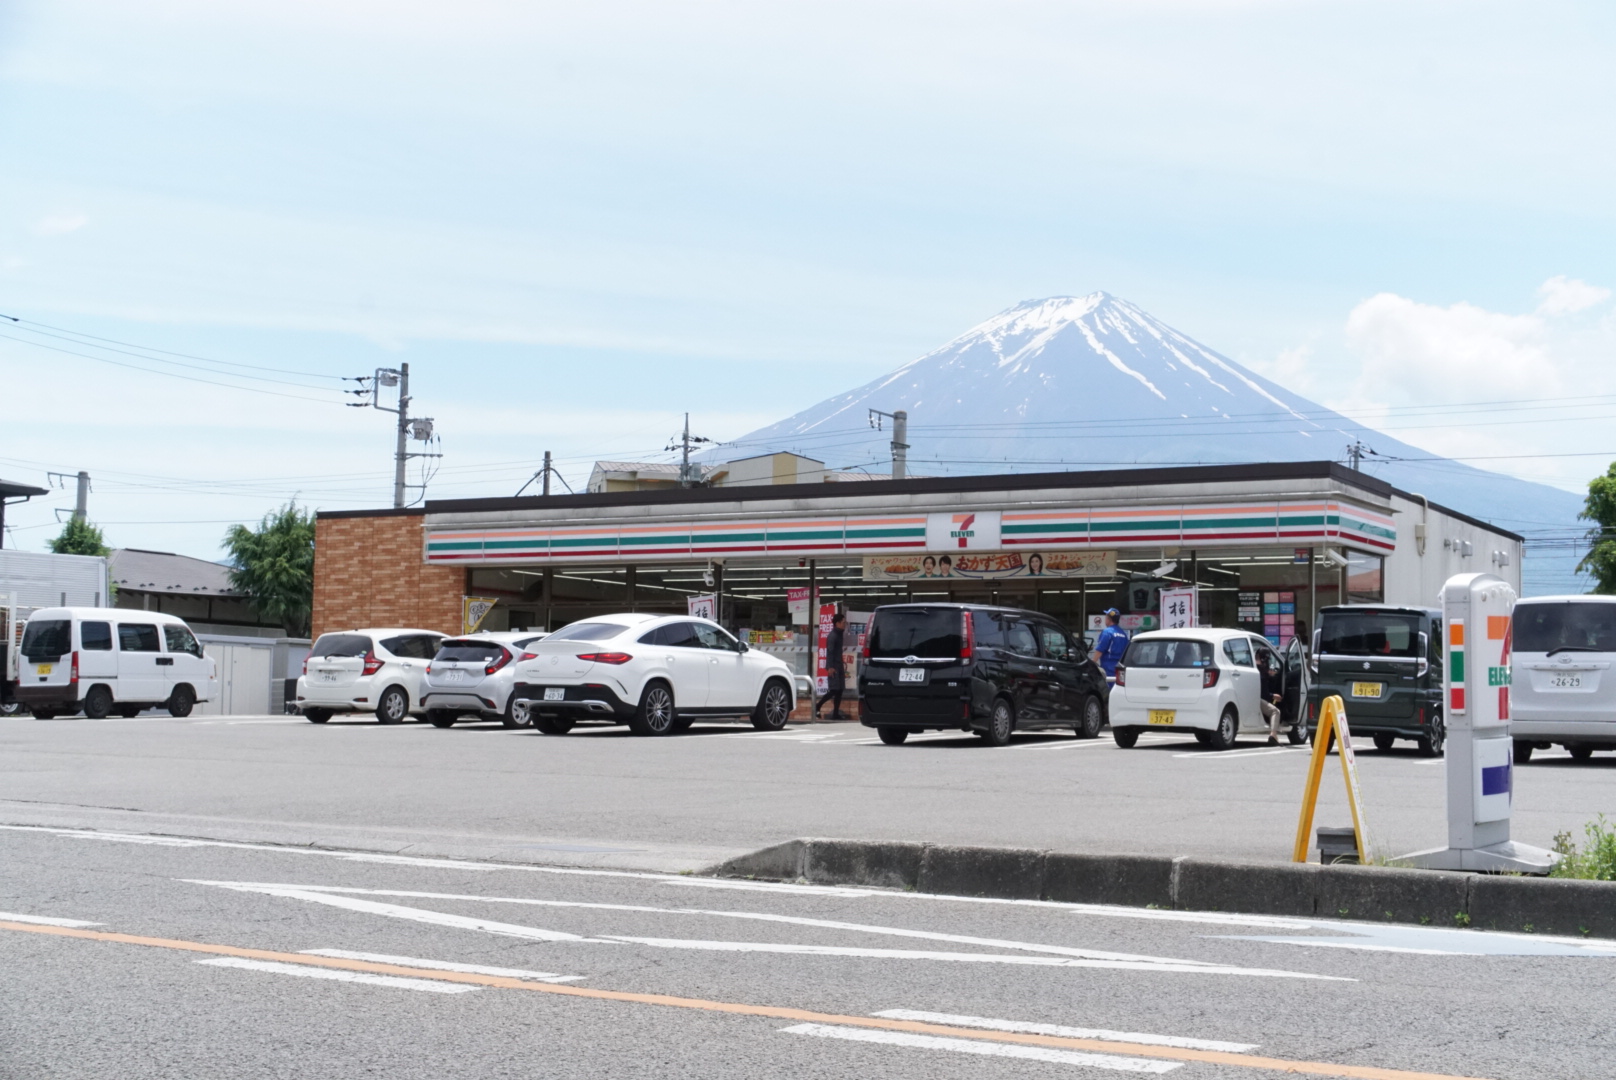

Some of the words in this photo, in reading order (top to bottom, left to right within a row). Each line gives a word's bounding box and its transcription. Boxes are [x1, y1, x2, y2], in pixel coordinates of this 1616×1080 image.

[952, 514, 975, 548] 7
[956, 552, 1023, 571] おかず天国
[1154, 716, 1174, 724] 37-43
